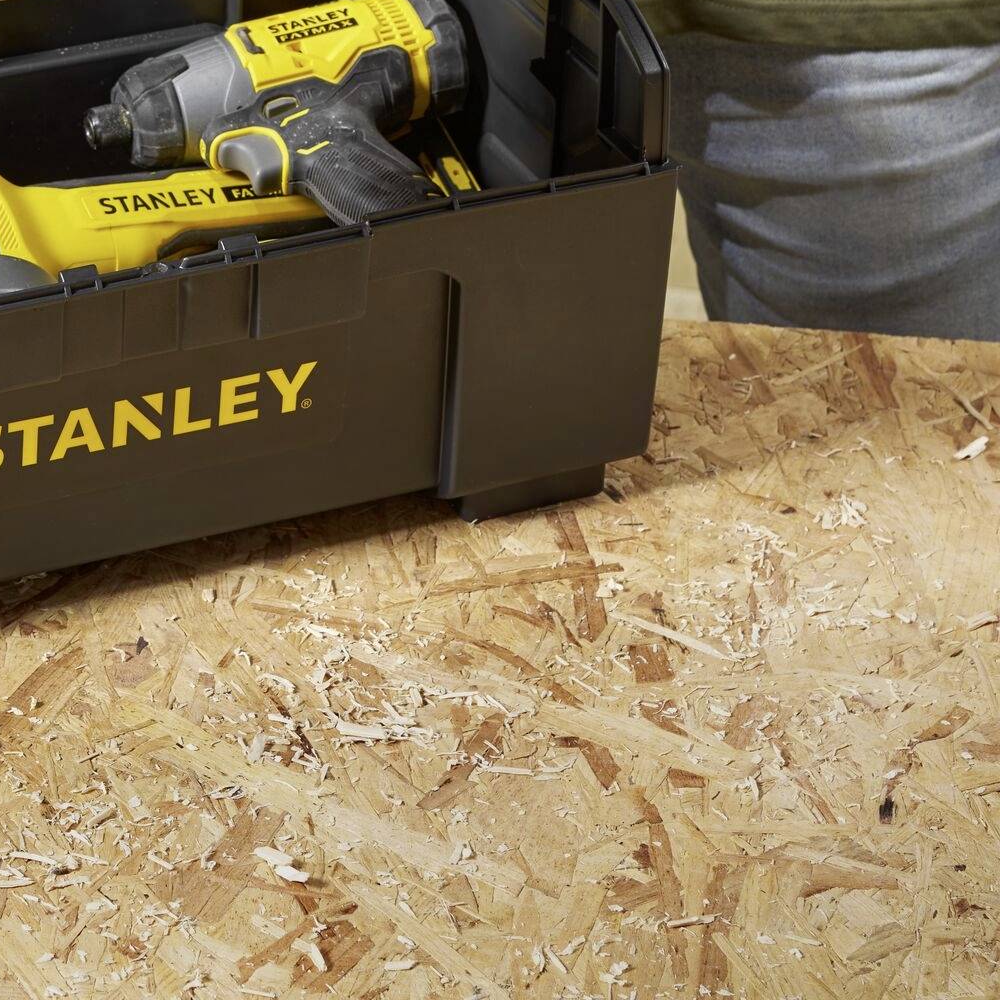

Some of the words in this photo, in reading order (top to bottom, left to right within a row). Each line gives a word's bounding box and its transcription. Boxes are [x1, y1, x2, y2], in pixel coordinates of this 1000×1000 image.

[268, 8, 348, 34] STANLEY
[280, 20, 353, 41] FATMAX
[99, 188, 216, 214] STANLEY
